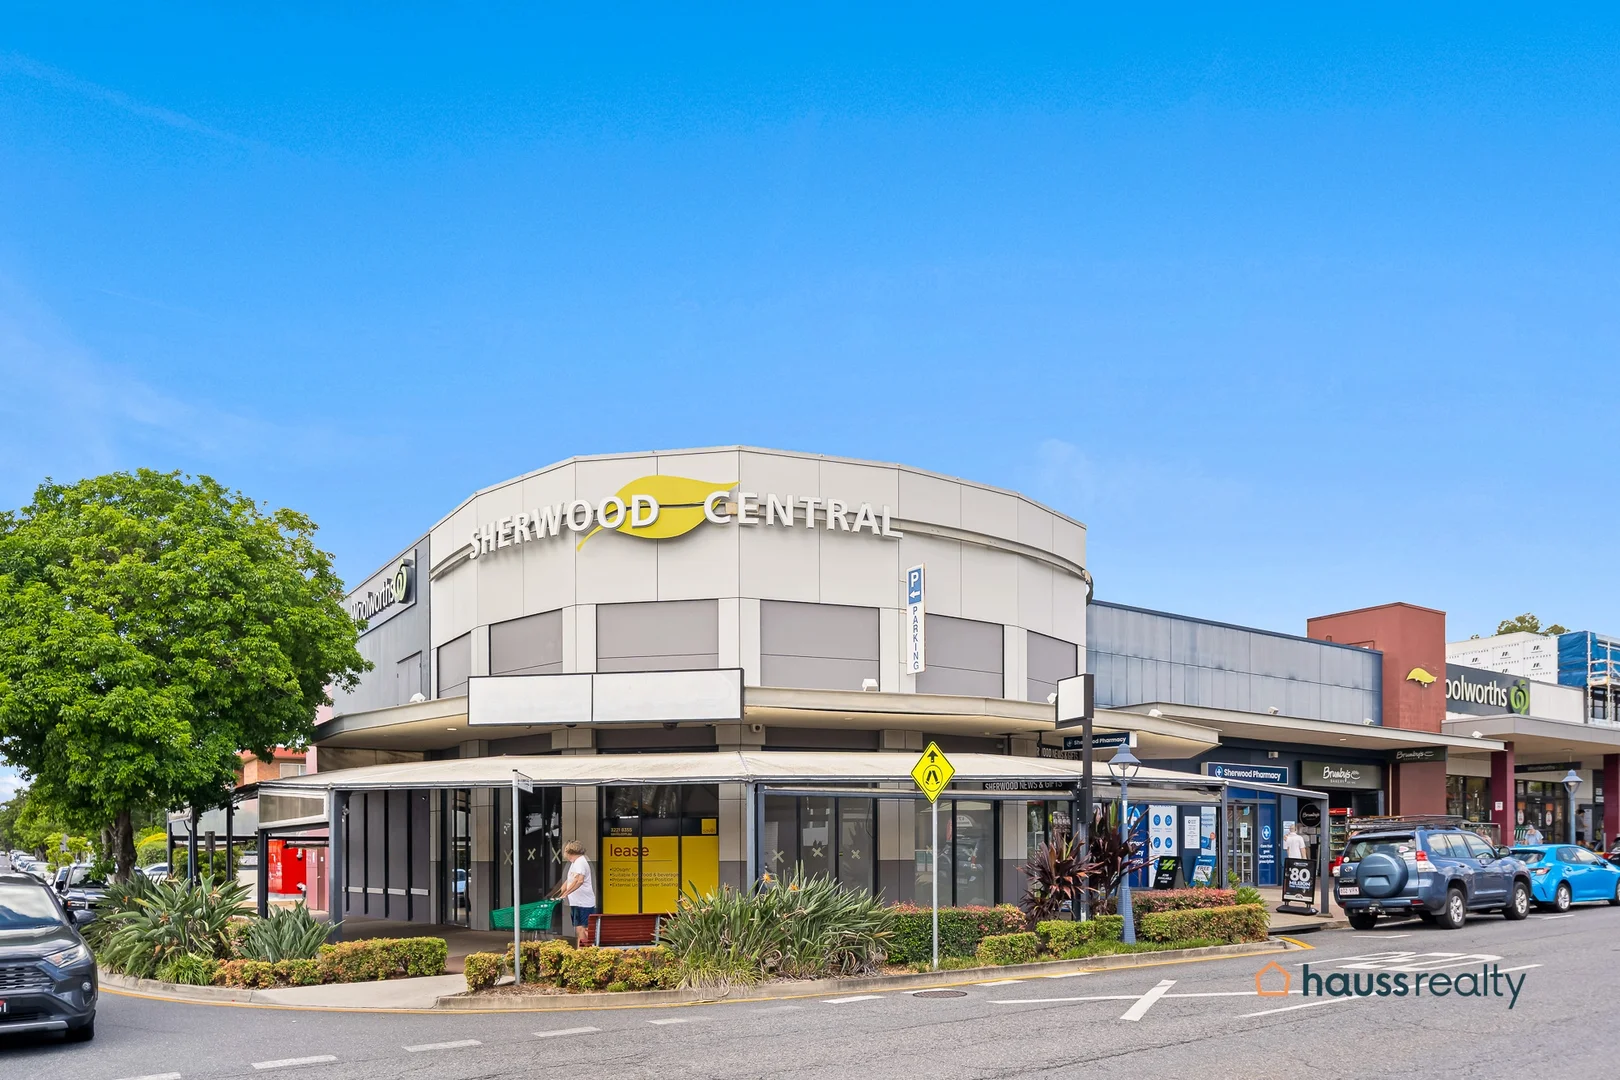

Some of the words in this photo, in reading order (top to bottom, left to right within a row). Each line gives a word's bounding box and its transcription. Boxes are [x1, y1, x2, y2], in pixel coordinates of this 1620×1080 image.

[469, 494, 660, 559] SHERWOOD
[704, 491, 903, 539] CENTRAL
[910, 571, 920, 588] P
[912, 606, 920, 671] PARKING
[1445, 674, 1508, 707] oolworths
[1223, 768, 1252, 778] Sherwood
[1252, 770, 1281, 781] Pharmacy
[1322, 766, 1351, 783] Brumby's
[984, 781, 1019, 791] SHERWOOD
[1019, 781, 1038, 790] NEWS
[1038, 781, 1044, 789] &
[610, 843, 650, 857] lease
